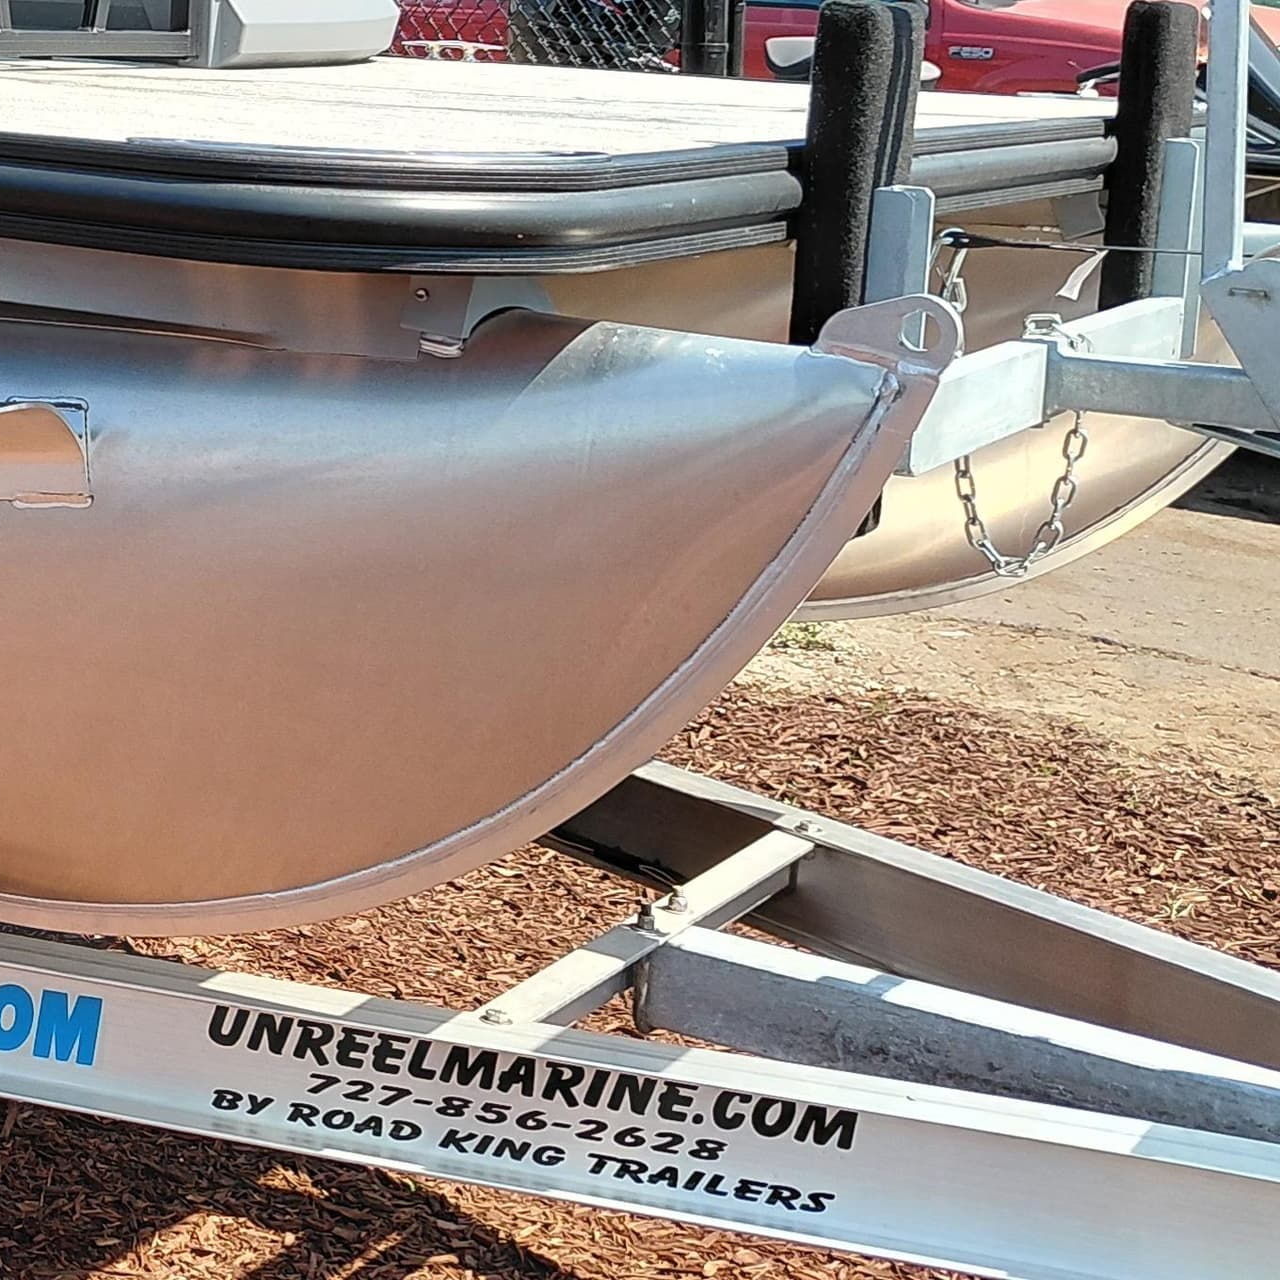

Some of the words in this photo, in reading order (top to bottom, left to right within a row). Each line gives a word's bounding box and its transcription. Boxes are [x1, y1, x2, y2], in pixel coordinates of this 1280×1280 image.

[207, 1004, 860, 1151] UNREELMARINE.COM
[306, 1072, 730, 1162] 727-856-2628
[211, 1089, 275, 1116] BY
[286, 1102, 423, 1141] ROAD
[437, 1128, 566, 1167] KING
[586, 1152, 837, 1214] TRAILERS
